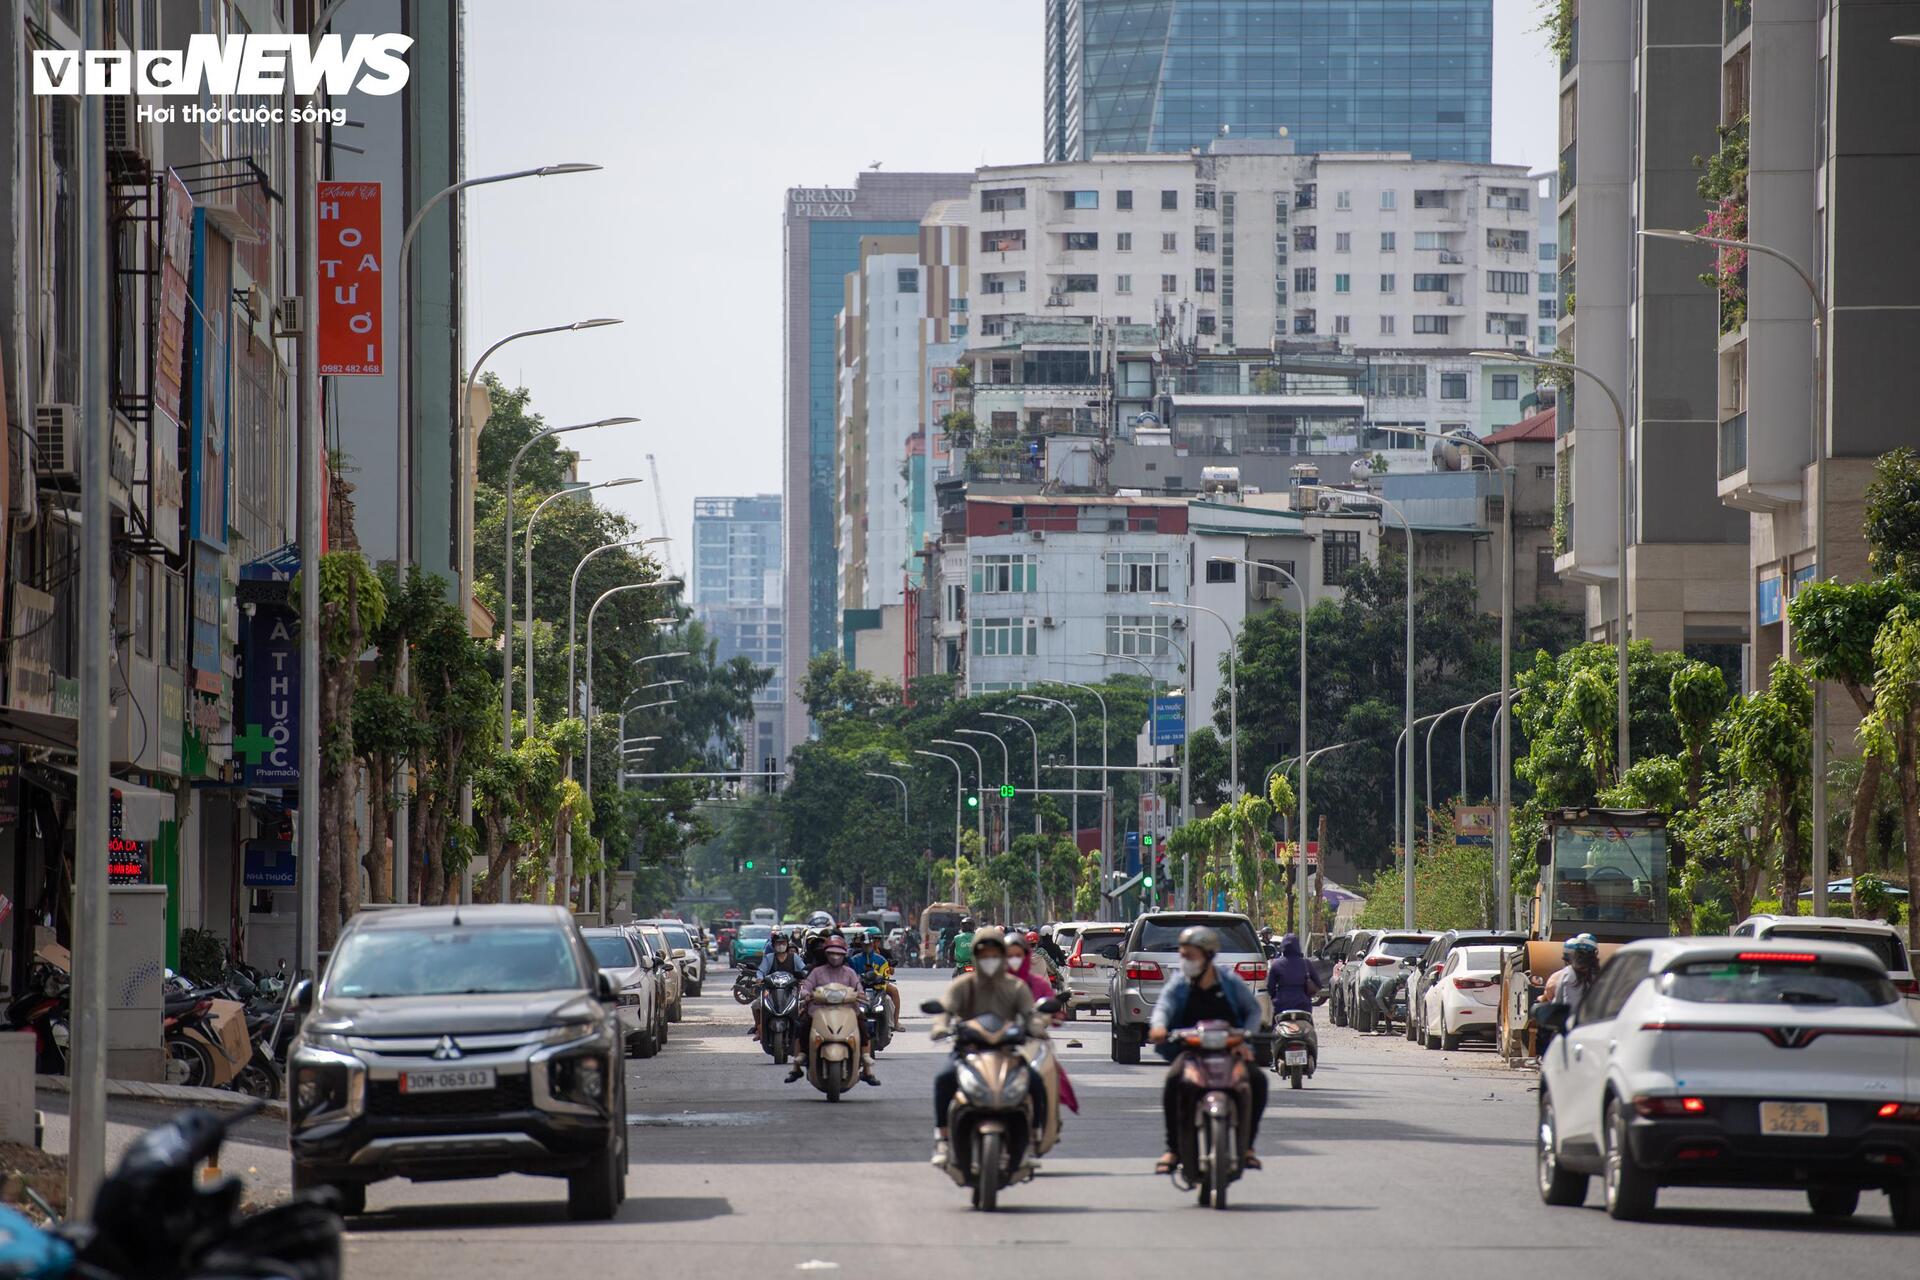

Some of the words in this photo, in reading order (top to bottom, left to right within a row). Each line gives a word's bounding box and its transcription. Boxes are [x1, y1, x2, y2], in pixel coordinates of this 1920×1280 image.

[791, 190, 857, 203] GRAND
[795, 203, 852, 217] PLAZA
[321, 364, 343, 373] 0982
[345, 364, 361, 373] 482
[362, 364, 380, 373] 468
